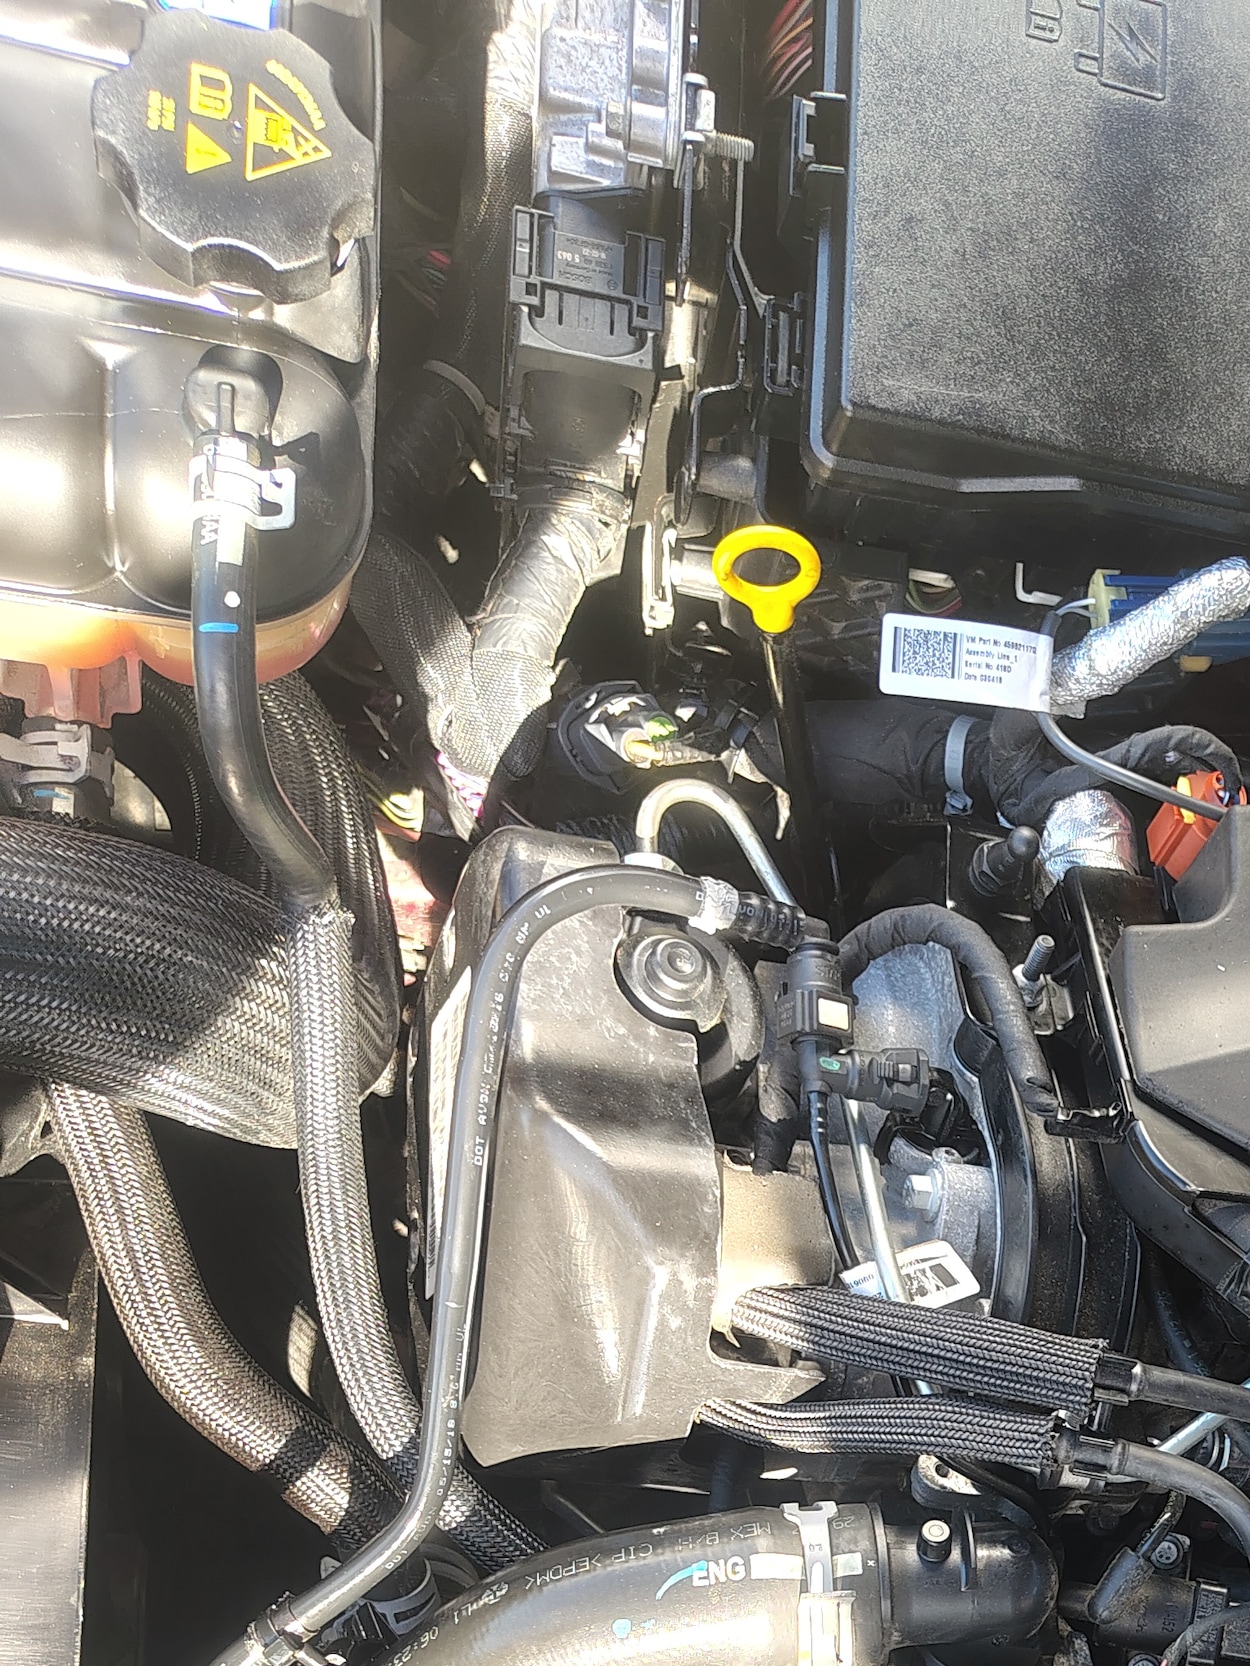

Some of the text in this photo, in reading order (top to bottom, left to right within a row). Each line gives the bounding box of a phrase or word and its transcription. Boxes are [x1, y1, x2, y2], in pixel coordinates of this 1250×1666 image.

[728, 1519, 771, 1541] MEX
[610, 1540, 653, 1564] CIP
[522, 1551, 602, 1590] >EPDM<
[692, 1556, 746, 1586] ENG
